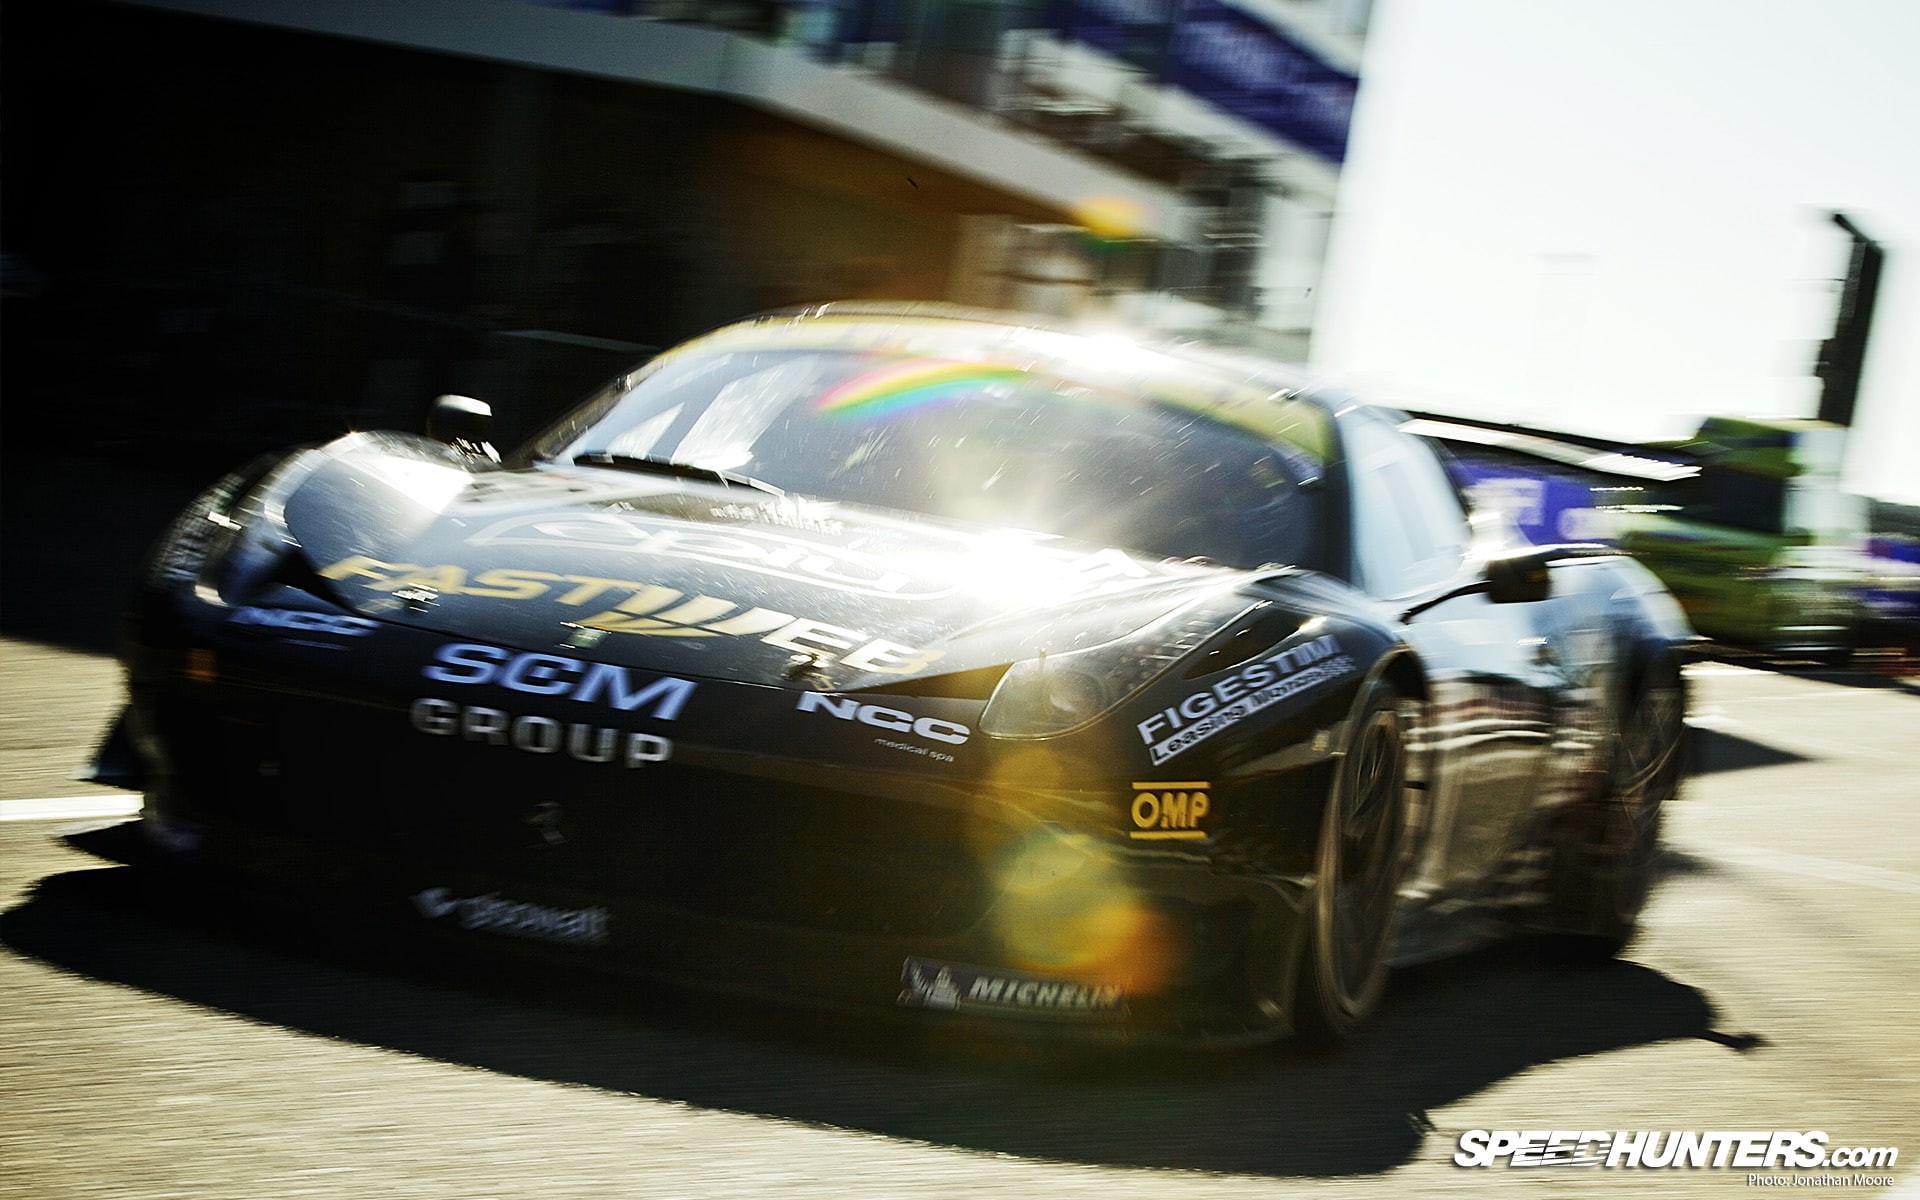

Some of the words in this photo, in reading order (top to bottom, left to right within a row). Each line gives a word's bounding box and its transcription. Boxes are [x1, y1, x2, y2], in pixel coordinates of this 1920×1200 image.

[316, 553, 948, 676] FASTWEB
[421, 642, 700, 721] SCM
[1136, 634, 1343, 745] FIGESTIM
[410, 697, 675, 769] GROUP
[873, 738, 929, 756] medical
[929, 751, 955, 763] spa
[1150, 701, 1251, 762] Leasing
[1131, 791, 1211, 829] OMP
[967, 975, 1124, 1011] MICHELIN
